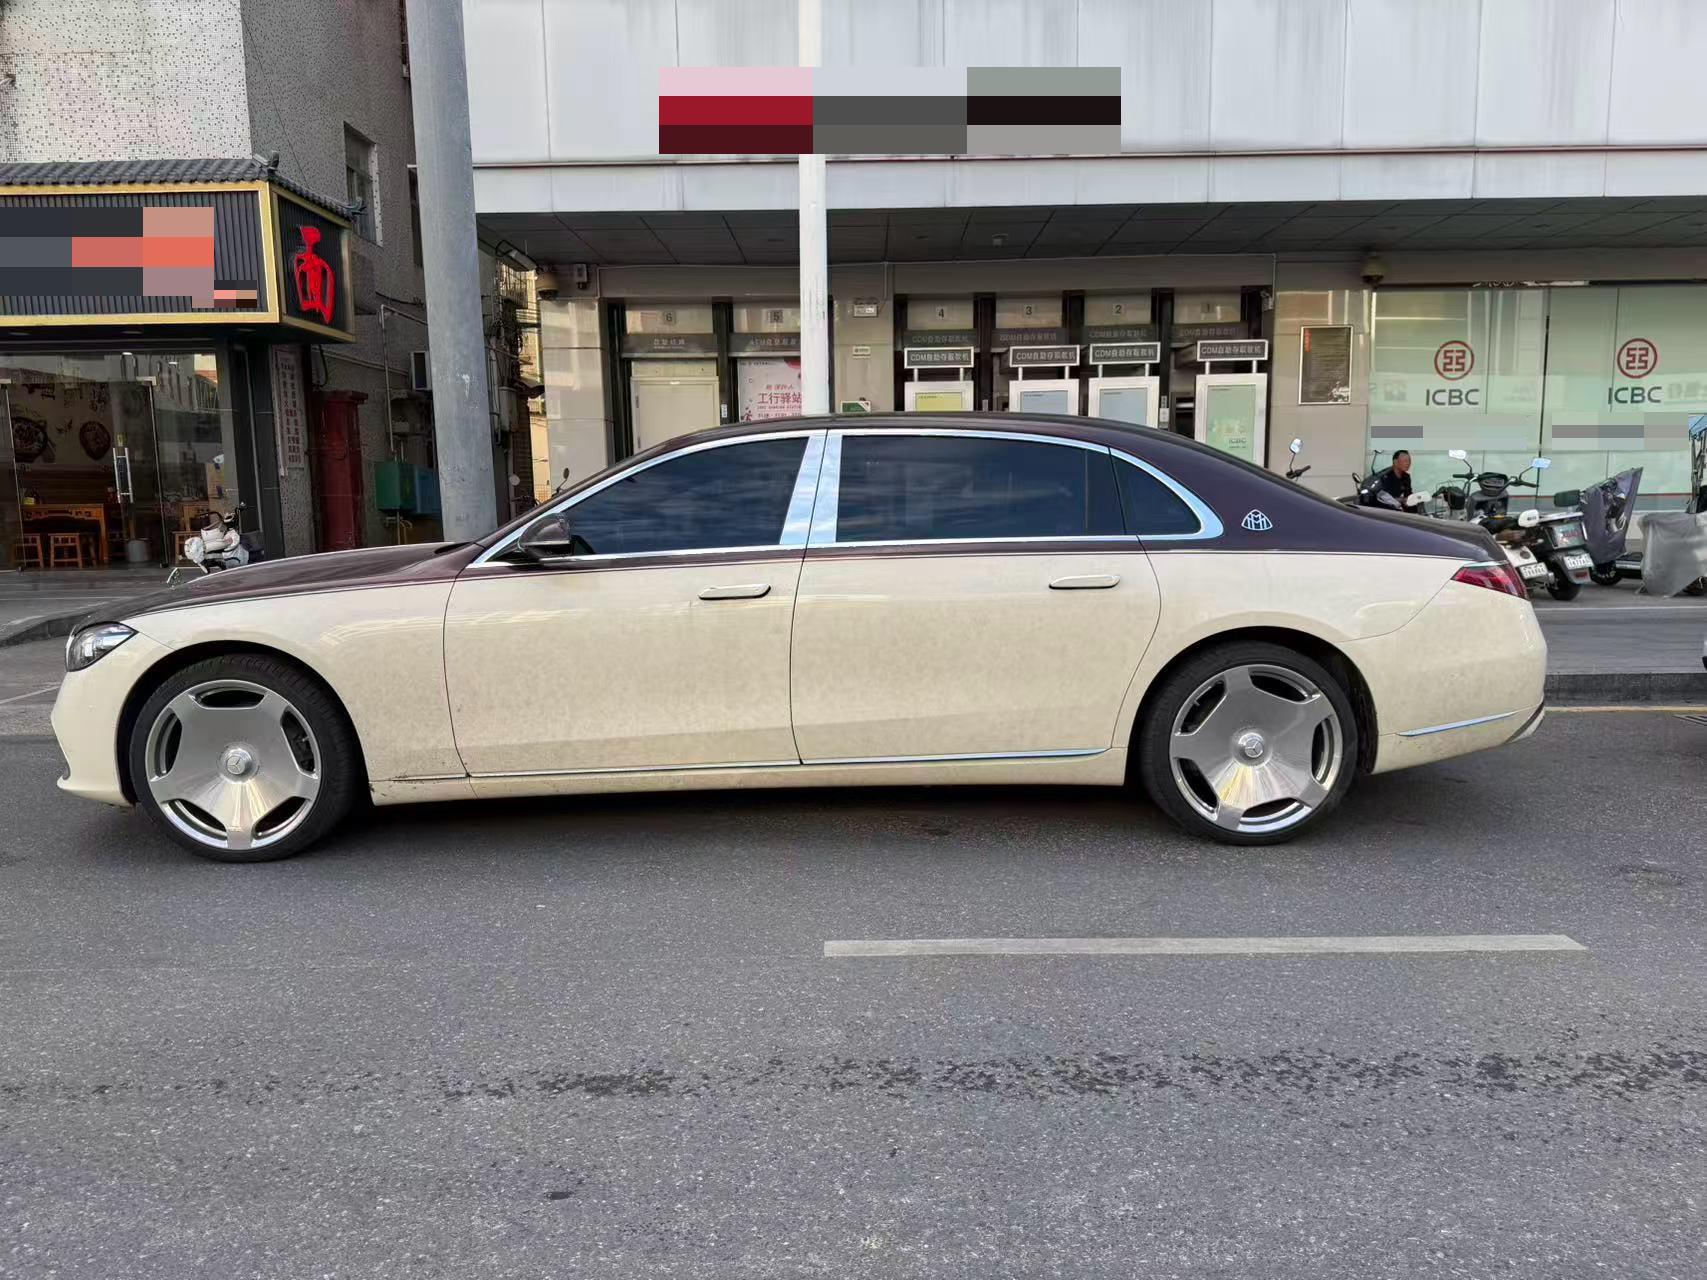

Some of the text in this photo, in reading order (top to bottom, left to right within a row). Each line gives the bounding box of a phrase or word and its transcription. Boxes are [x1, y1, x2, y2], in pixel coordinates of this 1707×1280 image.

[938, 308, 945, 318] 4
[1025, 306, 1033, 316] 3
[1114, 304, 1122, 314] 2
[664, 312, 673, 322] 6
[1425, 388, 1480, 406] ICBC
[1608, 386, 1663, 404] ICBC
